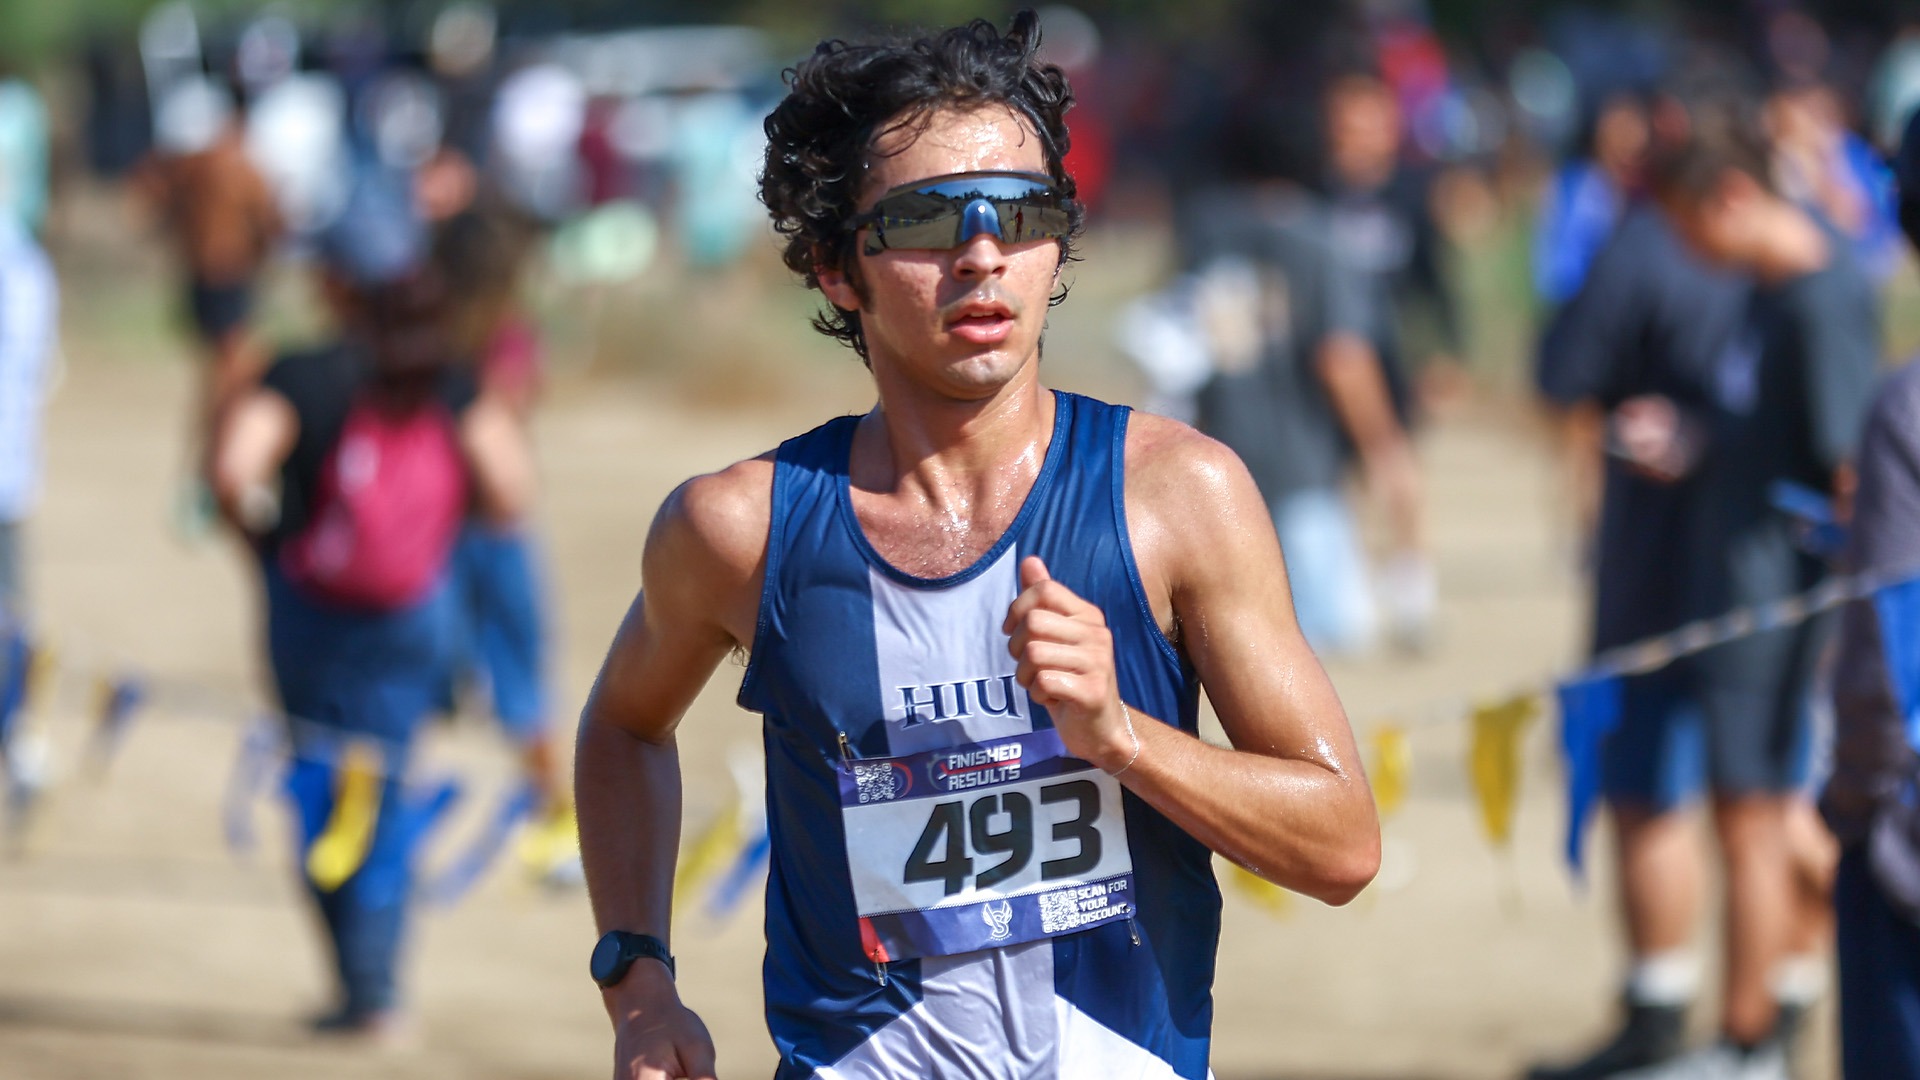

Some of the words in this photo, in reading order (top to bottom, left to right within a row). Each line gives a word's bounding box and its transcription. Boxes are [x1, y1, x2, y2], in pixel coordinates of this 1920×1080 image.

[896, 673, 1022, 729] HIU
[948, 743, 1022, 770] FINISHED
[948, 764, 1020, 790] RESULTS
[903, 779, 1102, 897] 493
[1077, 884, 1106, 900] SCAN
[1108, 880, 1127, 894] FOR
[1079, 896, 1108, 912] YOUR
[1080, 903, 1128, 925] DISCOUNT
